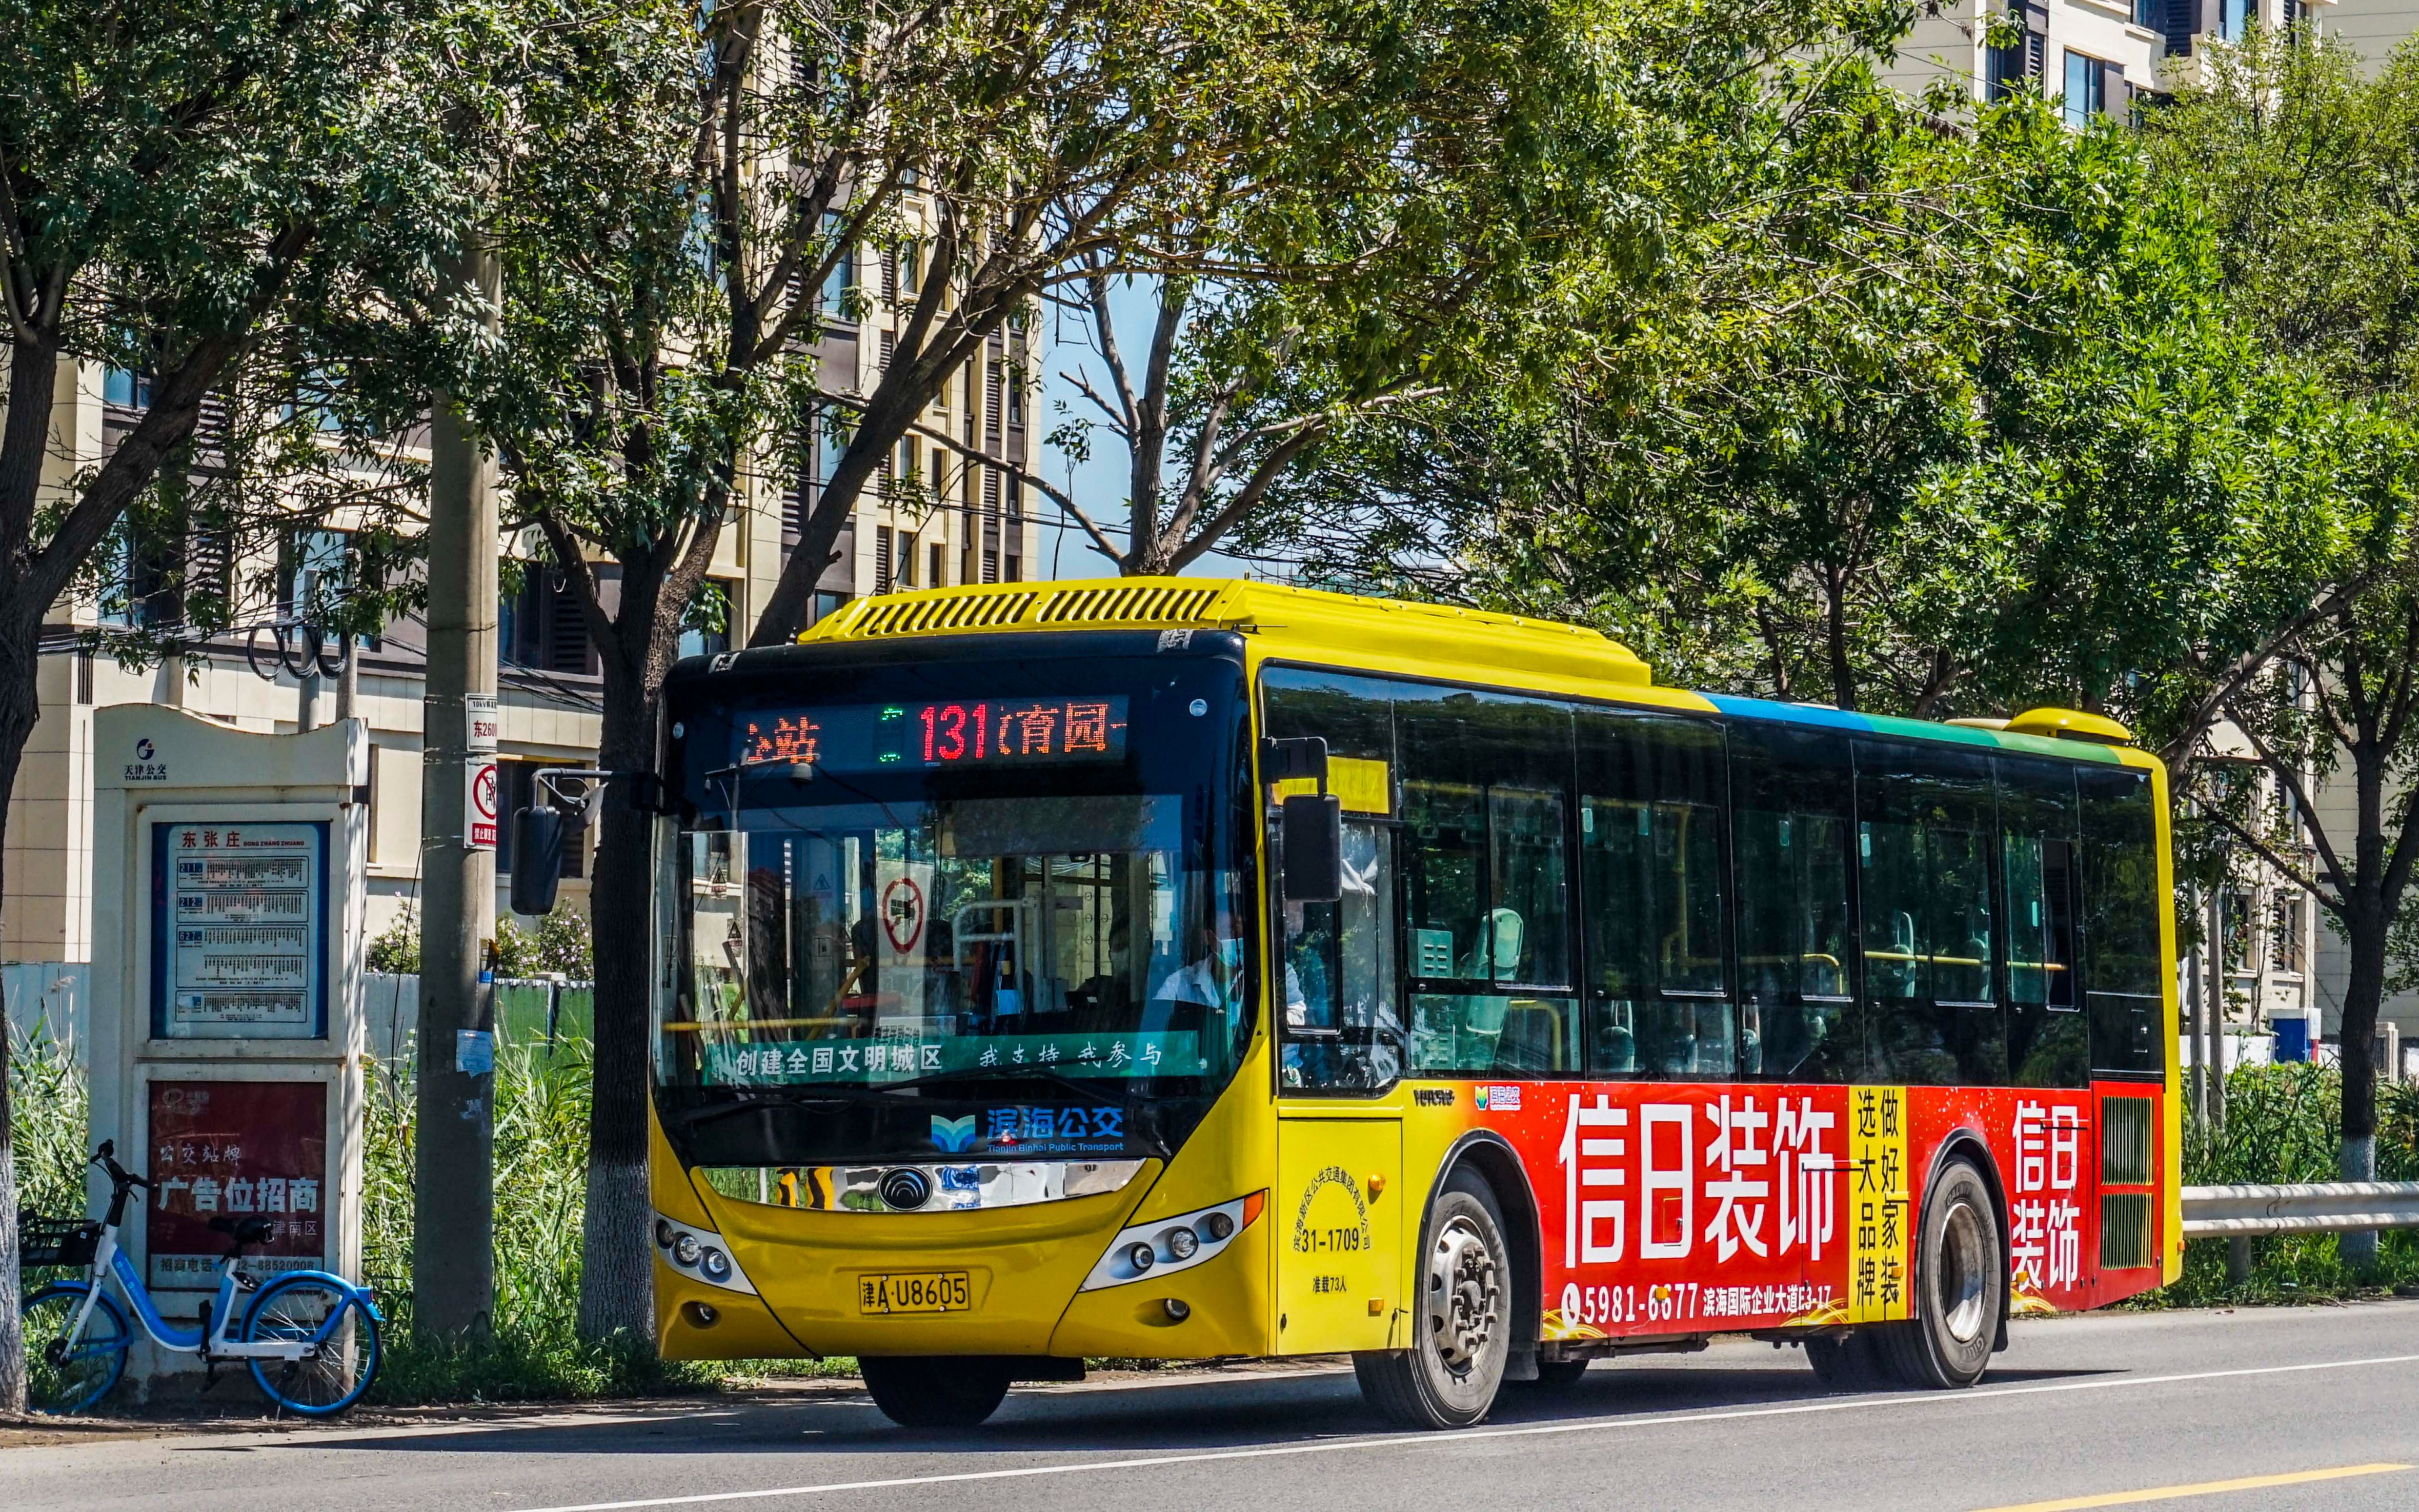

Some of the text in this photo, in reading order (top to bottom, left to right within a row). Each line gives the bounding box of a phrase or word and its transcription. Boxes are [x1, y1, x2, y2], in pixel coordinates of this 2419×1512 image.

[921, 704, 985, 761] 131
[125, 764, 166, 775] 天津公交
[183, 831, 240, 847] 东张庄
[179, 932, 195, 940] 627
[736, 1043, 942, 1076] 创建全国文明城区
[987, 1107, 1123, 1140] 滨海公交
[160, 1142, 241, 1166] 公交站牌
[987, 1142, 1124, 1154] Tianjin Binhai Public Transport
[2012, 1100, 2078, 1194] 信日
[158, 1176, 318, 1213] 广告位招商
[1559, 1093, 1835, 1269] 信日装饰
[1857, 1088, 1876, 1307] 选大品牌
[1880, 1089, 1900, 1305] 做好家装
[273, 1220, 317, 1236] 津南区
[1302, 1227, 1359, 1253] 31-1709
[2011, 1198, 2080, 1293] 装饰
[1313, 1276, 1347, 1294] 准载73人
[1584, 1283, 1831, 1324] 5981-6677 滨海国际企业大道E3-17
